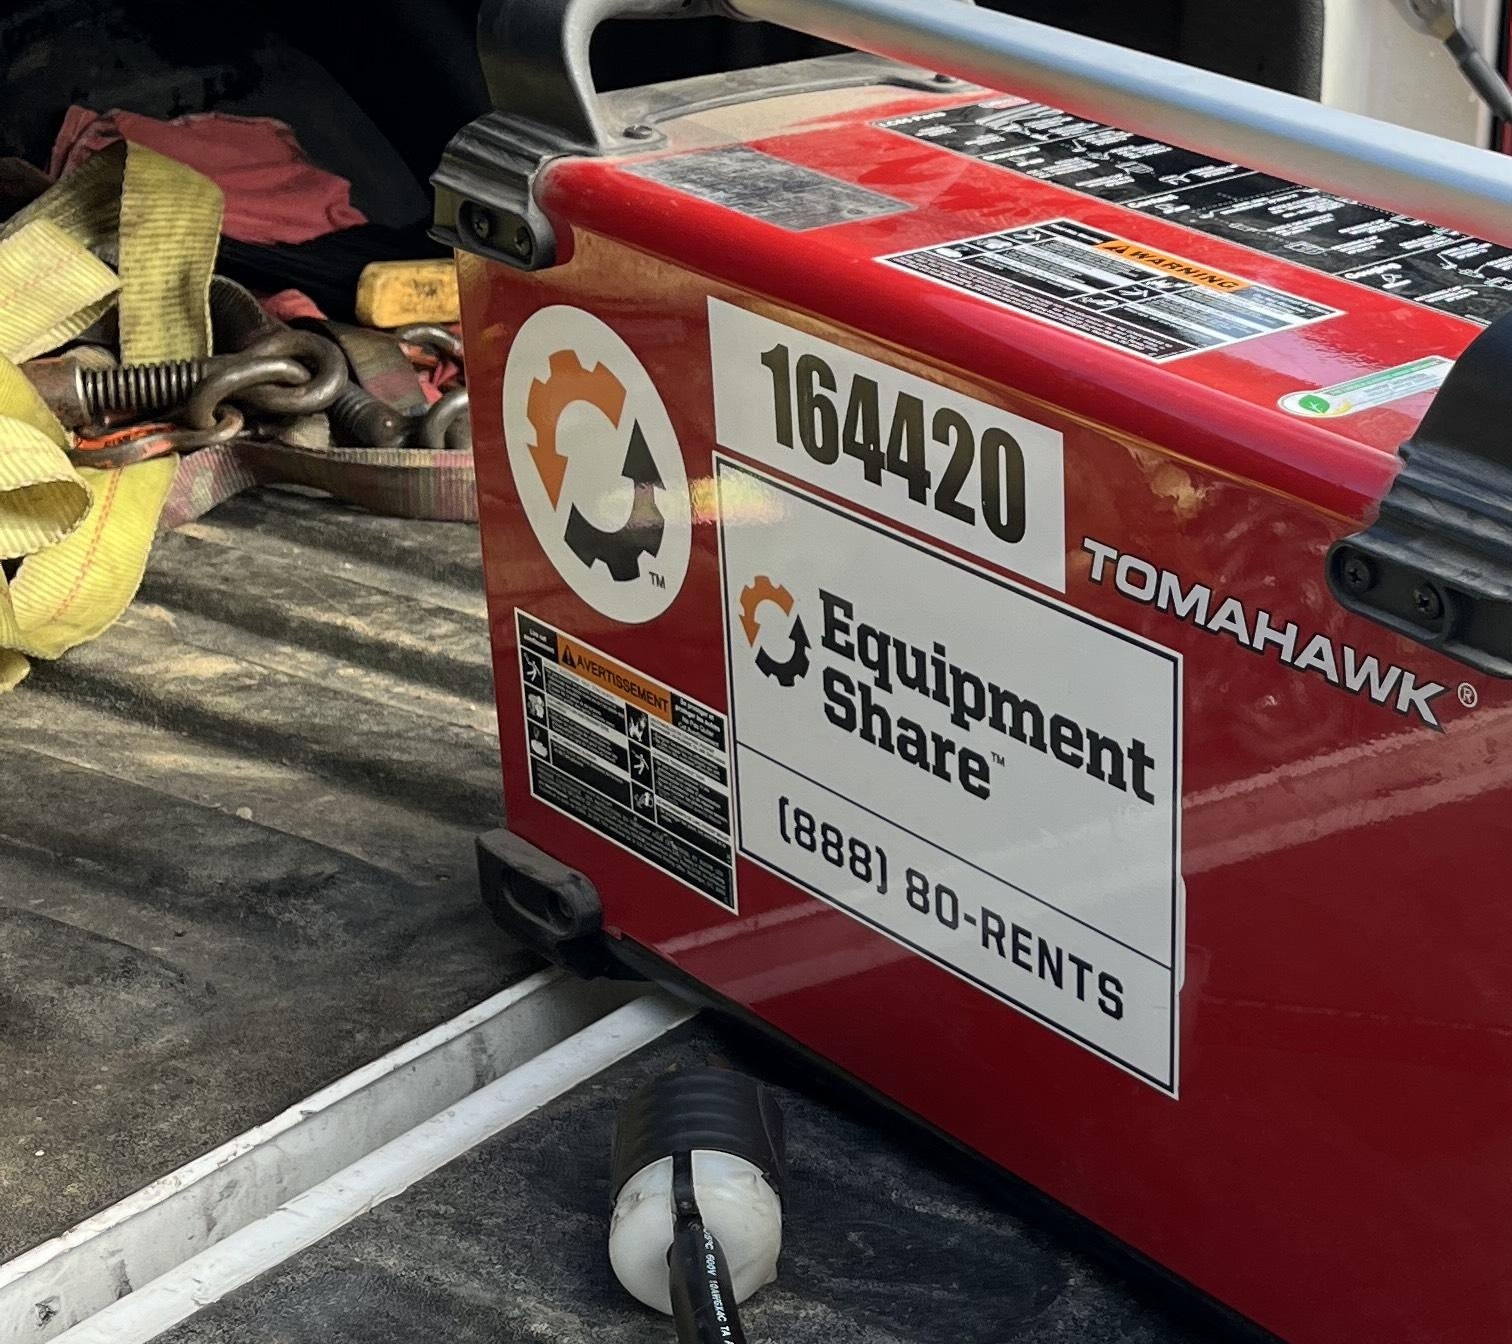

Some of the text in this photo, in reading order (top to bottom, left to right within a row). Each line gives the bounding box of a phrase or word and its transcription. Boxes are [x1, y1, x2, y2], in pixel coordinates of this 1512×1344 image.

[1129, 250, 1240, 290] WARNING
[759, 342, 1027, 545] 164420
[576, 655, 669, 714] AVERTISSEMENT
[819, 588, 1155, 805] Equipment
[1082, 537, 1449, 733] TOMAHAWK
[823, 666, 991, 801] Share
[778, 796, 1124, 1022] (888) 80-RENTS
[720, 1325, 732, 1337] TA
